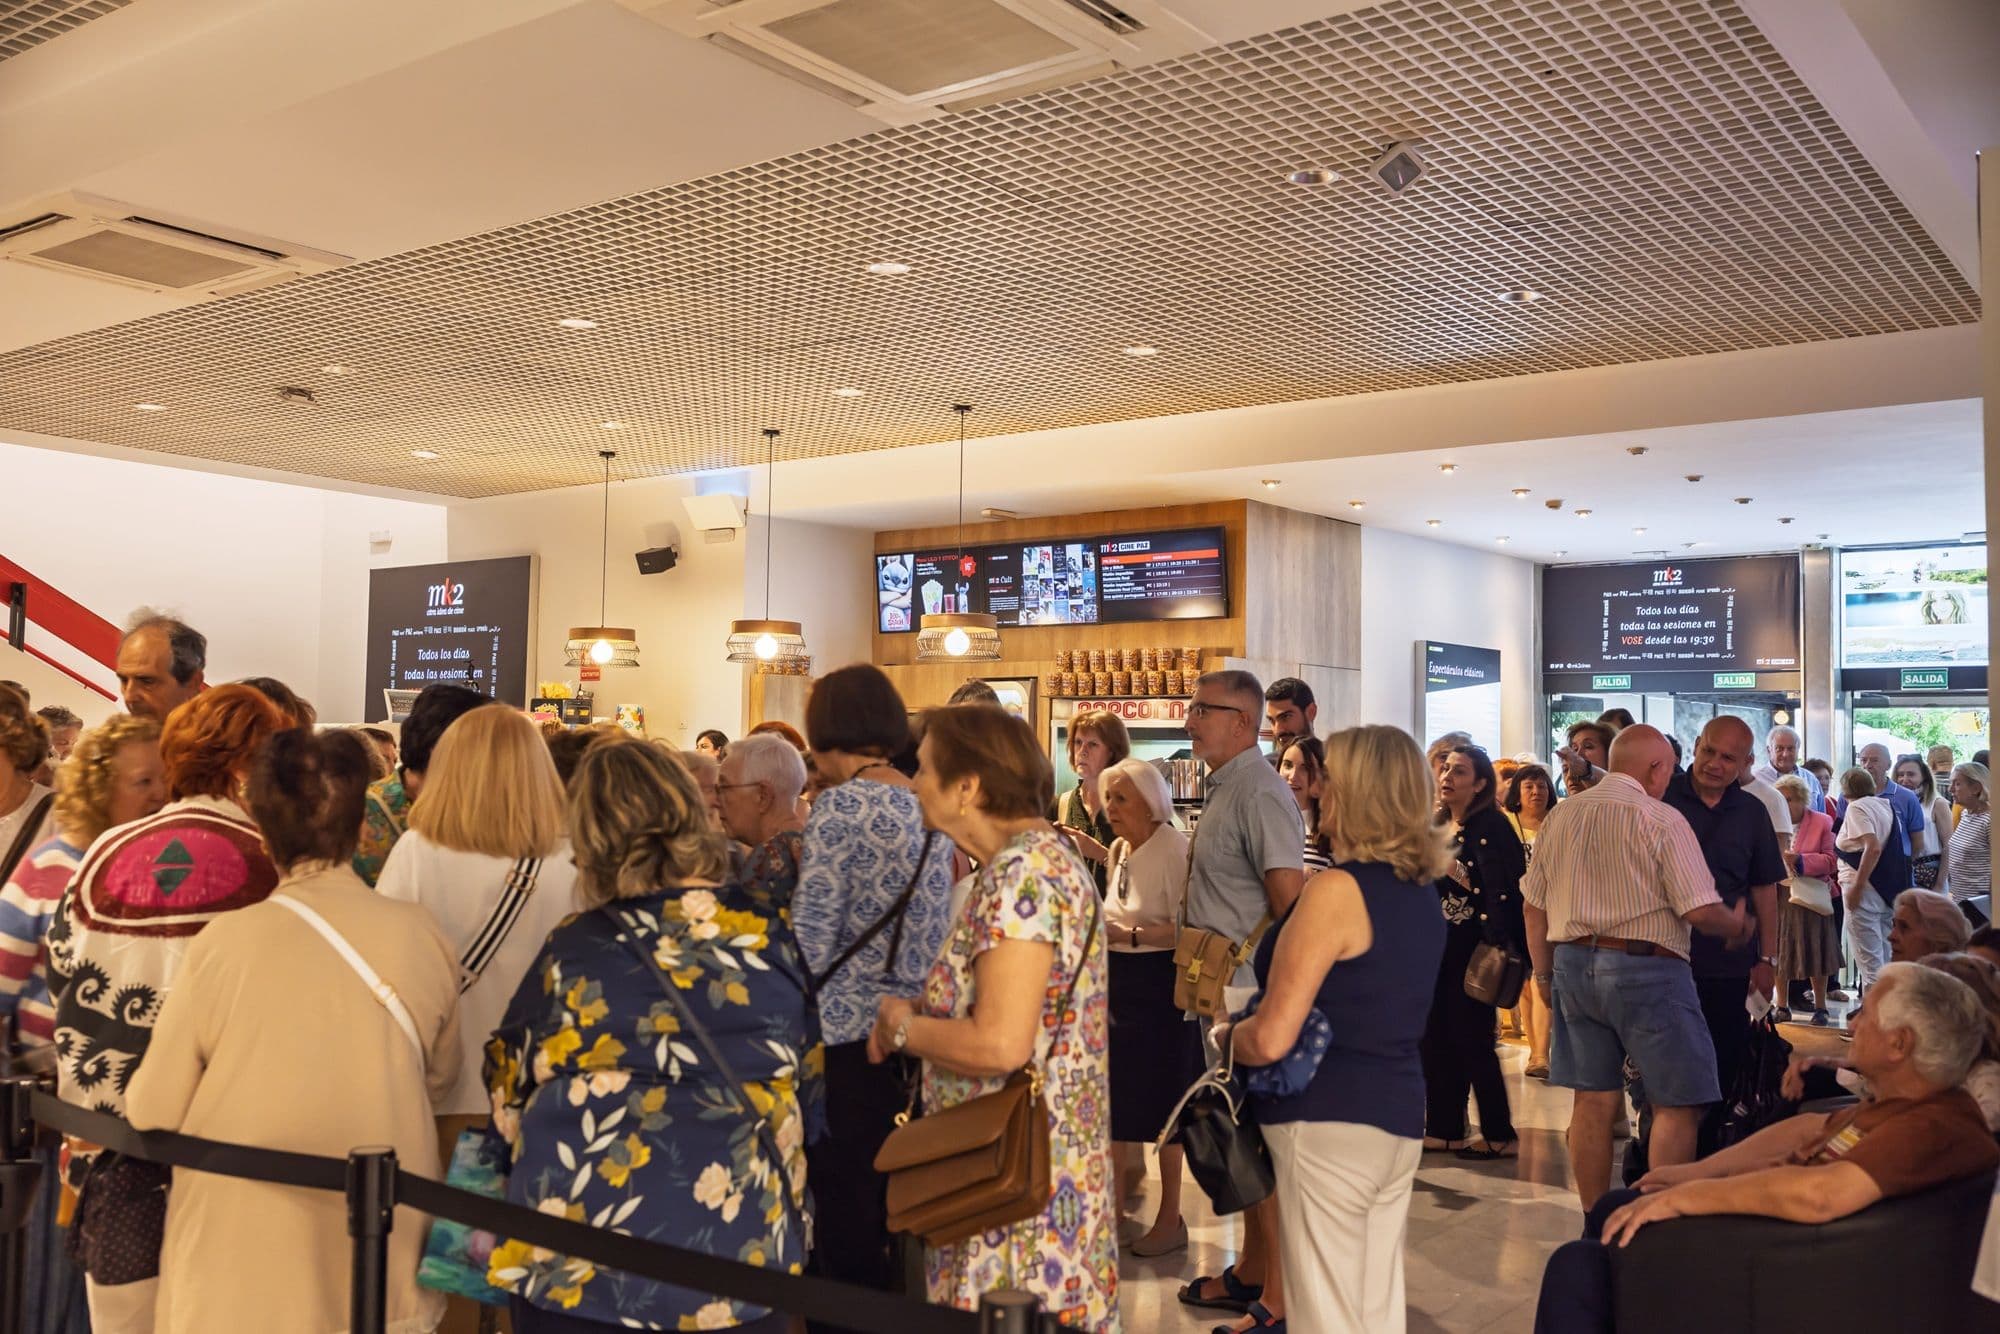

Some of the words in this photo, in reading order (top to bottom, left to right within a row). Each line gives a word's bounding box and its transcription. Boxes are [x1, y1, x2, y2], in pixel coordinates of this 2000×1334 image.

[1653, 566, 1682, 582] mk2
[428, 577, 464, 607] mk2
[1636, 606, 1661, 616] Todos
[1664, 606, 1677, 614] los
[1680, 605, 1700, 614] días
[1620, 622, 1645, 631] todas
[1647, 621, 1660, 630] las
[1663, 620, 1701, 629] sesiones
[1621, 636, 1644, 645] VOSE
[1645, 636, 1670, 644] desde
[1673, 636, 1687, 644] las
[1690, 636, 1714, 645] 19:30
[418, 649, 438, 660] Todos
[440, 648, 451, 660] los
[453, 647, 470, 659] días
[405, 669, 425, 680] todas
[426, 668, 438, 679] las
[439, 668, 470, 679] sesione
[473, 668, 482, 678] en
[1596, 678, 1628, 686] SALIDA
[1717, 676, 1752, 685] SALIDA
[1904, 674, 1945, 686] SALIDA
